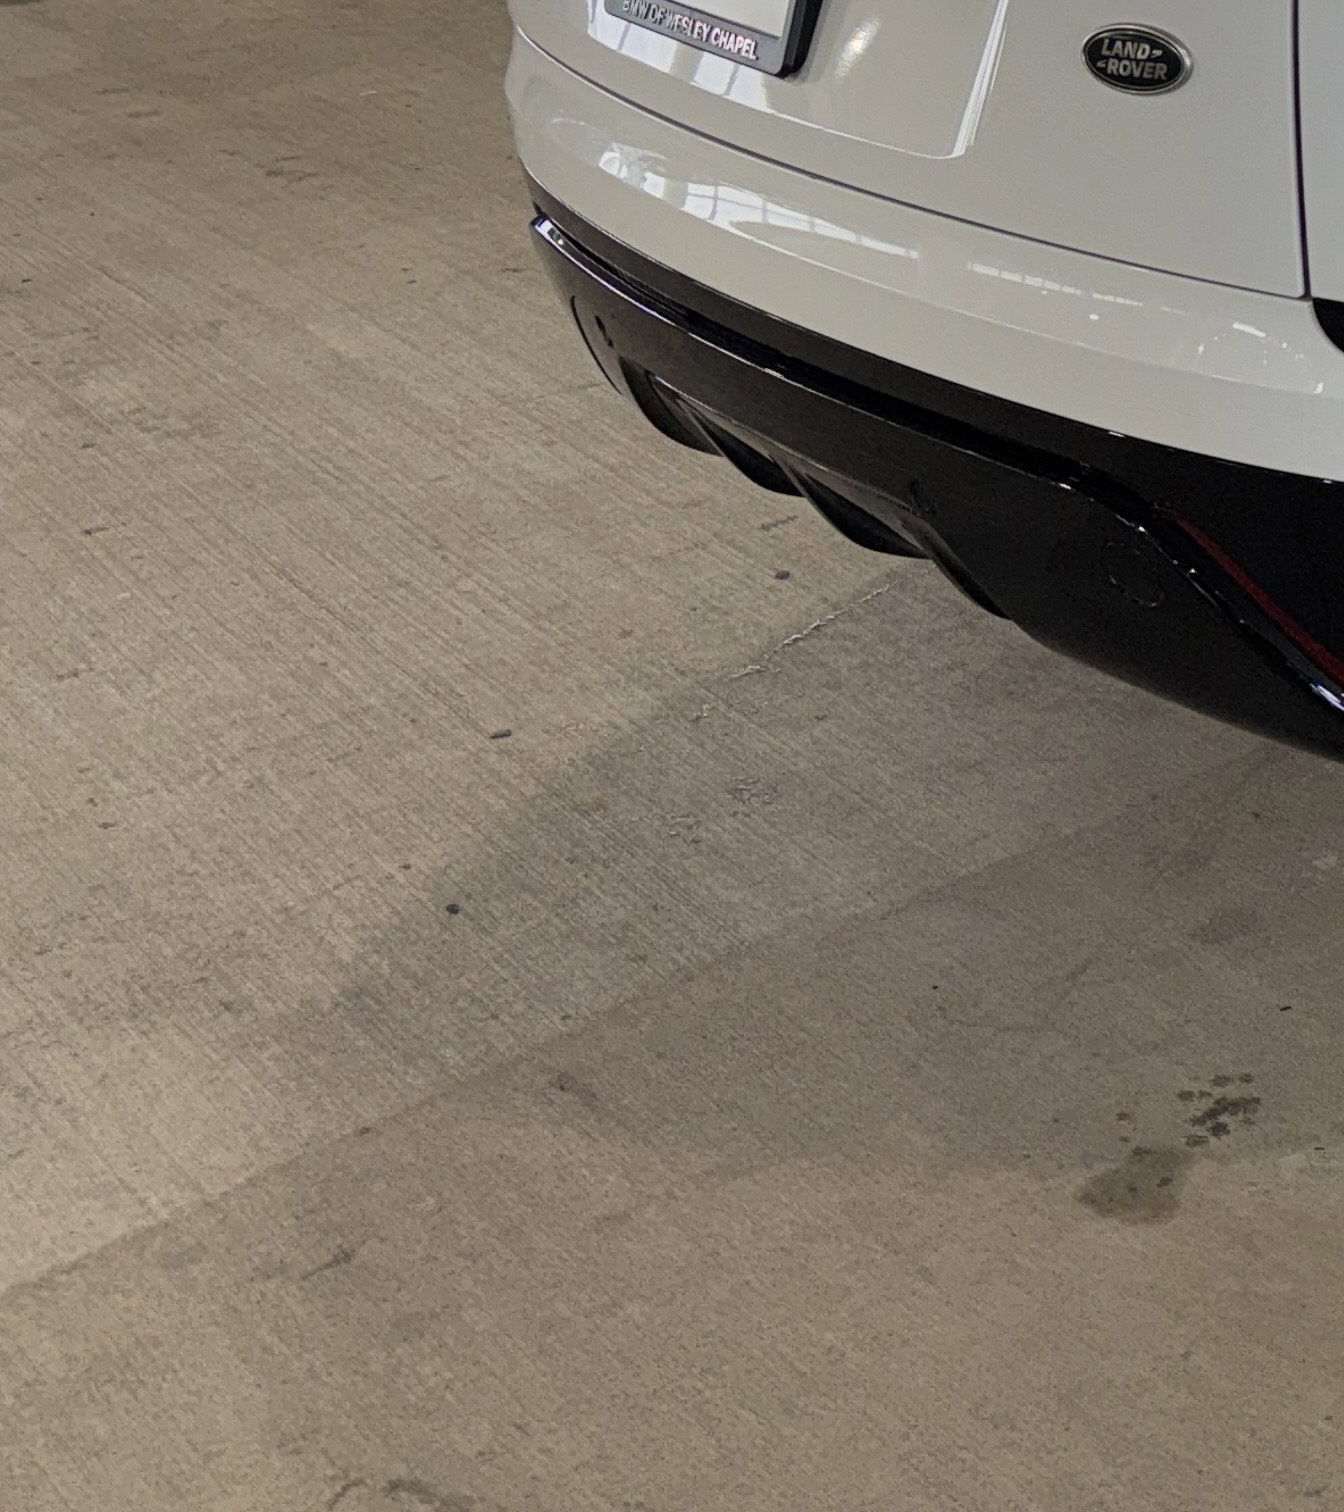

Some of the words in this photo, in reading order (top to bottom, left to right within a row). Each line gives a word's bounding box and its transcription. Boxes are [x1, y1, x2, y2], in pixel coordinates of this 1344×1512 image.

[649, 3, 667, 25] OF
[666, 9, 711, 41] WESLEY
[710, 26, 759, 60] CHAPEL
[1101, 38, 1151, 59] LAND
[1107, 58, 1168, 80] ROVER
